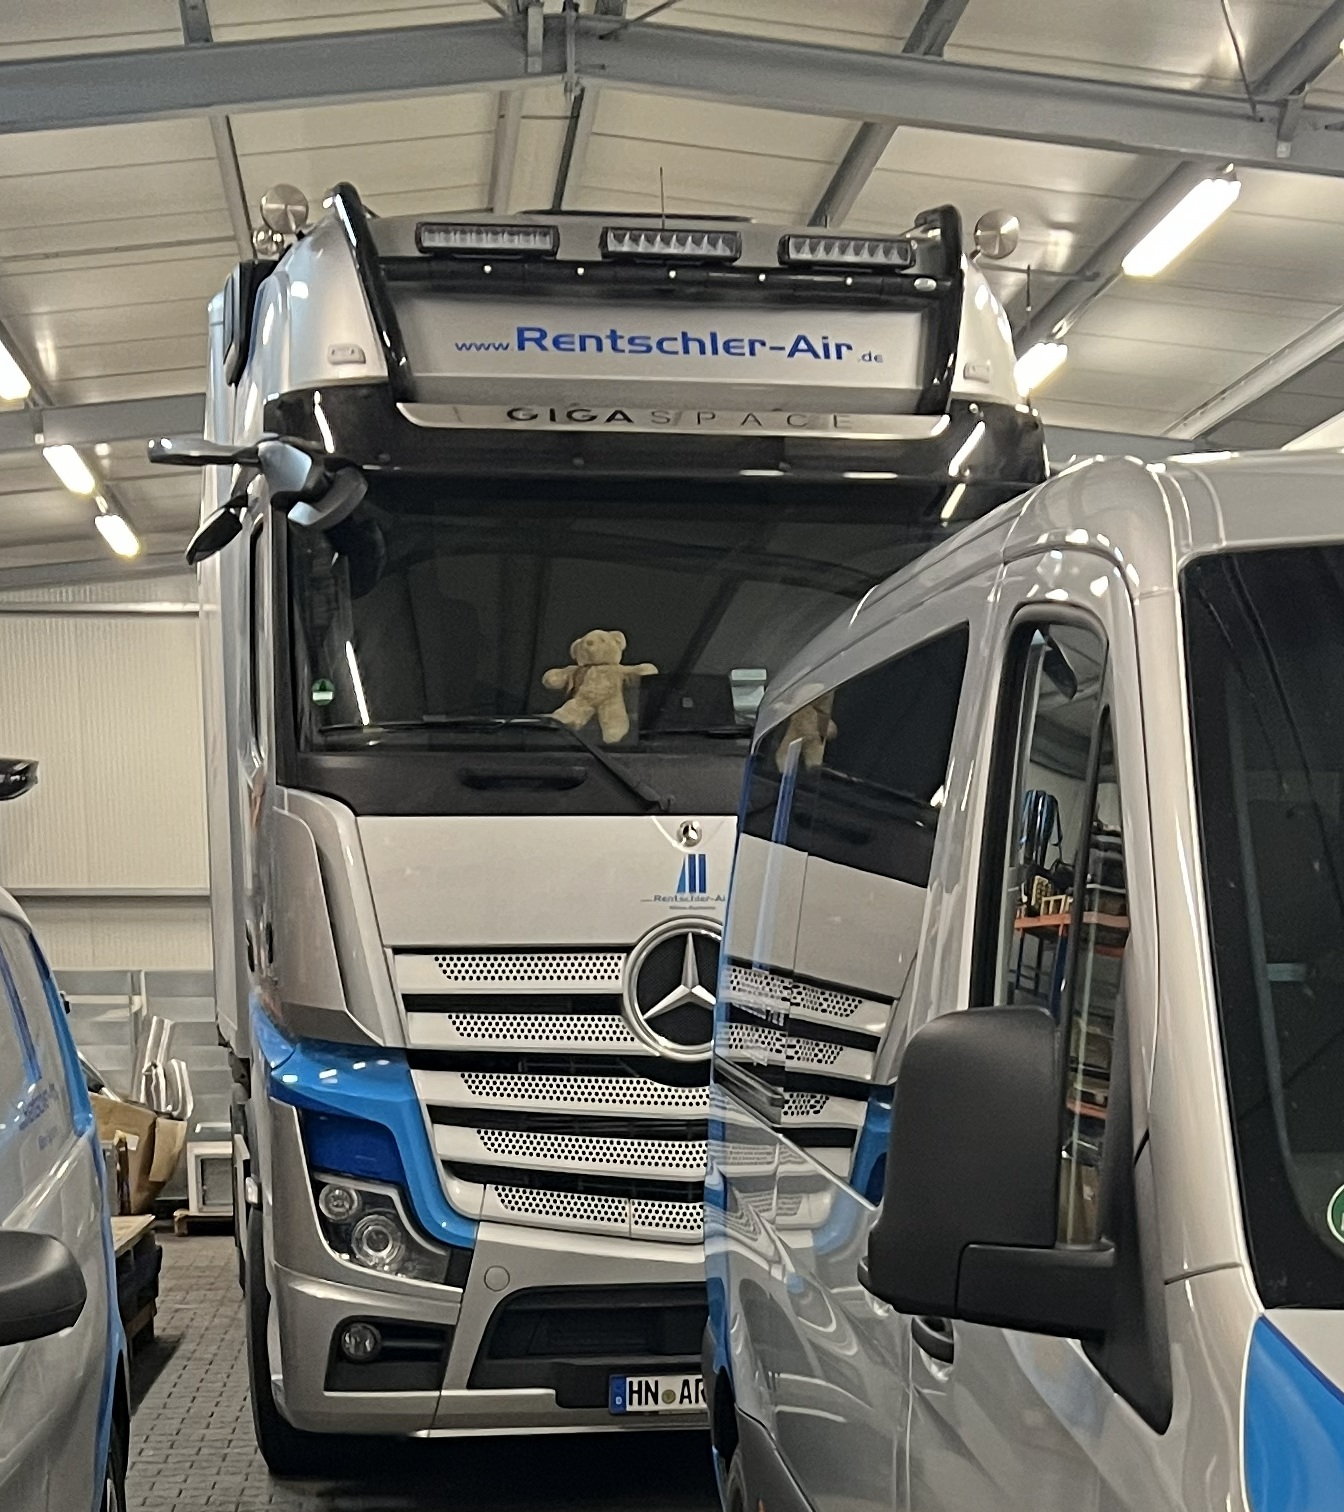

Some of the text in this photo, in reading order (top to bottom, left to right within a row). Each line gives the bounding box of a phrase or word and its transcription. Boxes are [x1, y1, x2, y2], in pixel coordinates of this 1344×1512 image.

[455, 326, 884, 363] www.Rentschler-Air.de
[628, 1378, 707, 1406] HN AR
